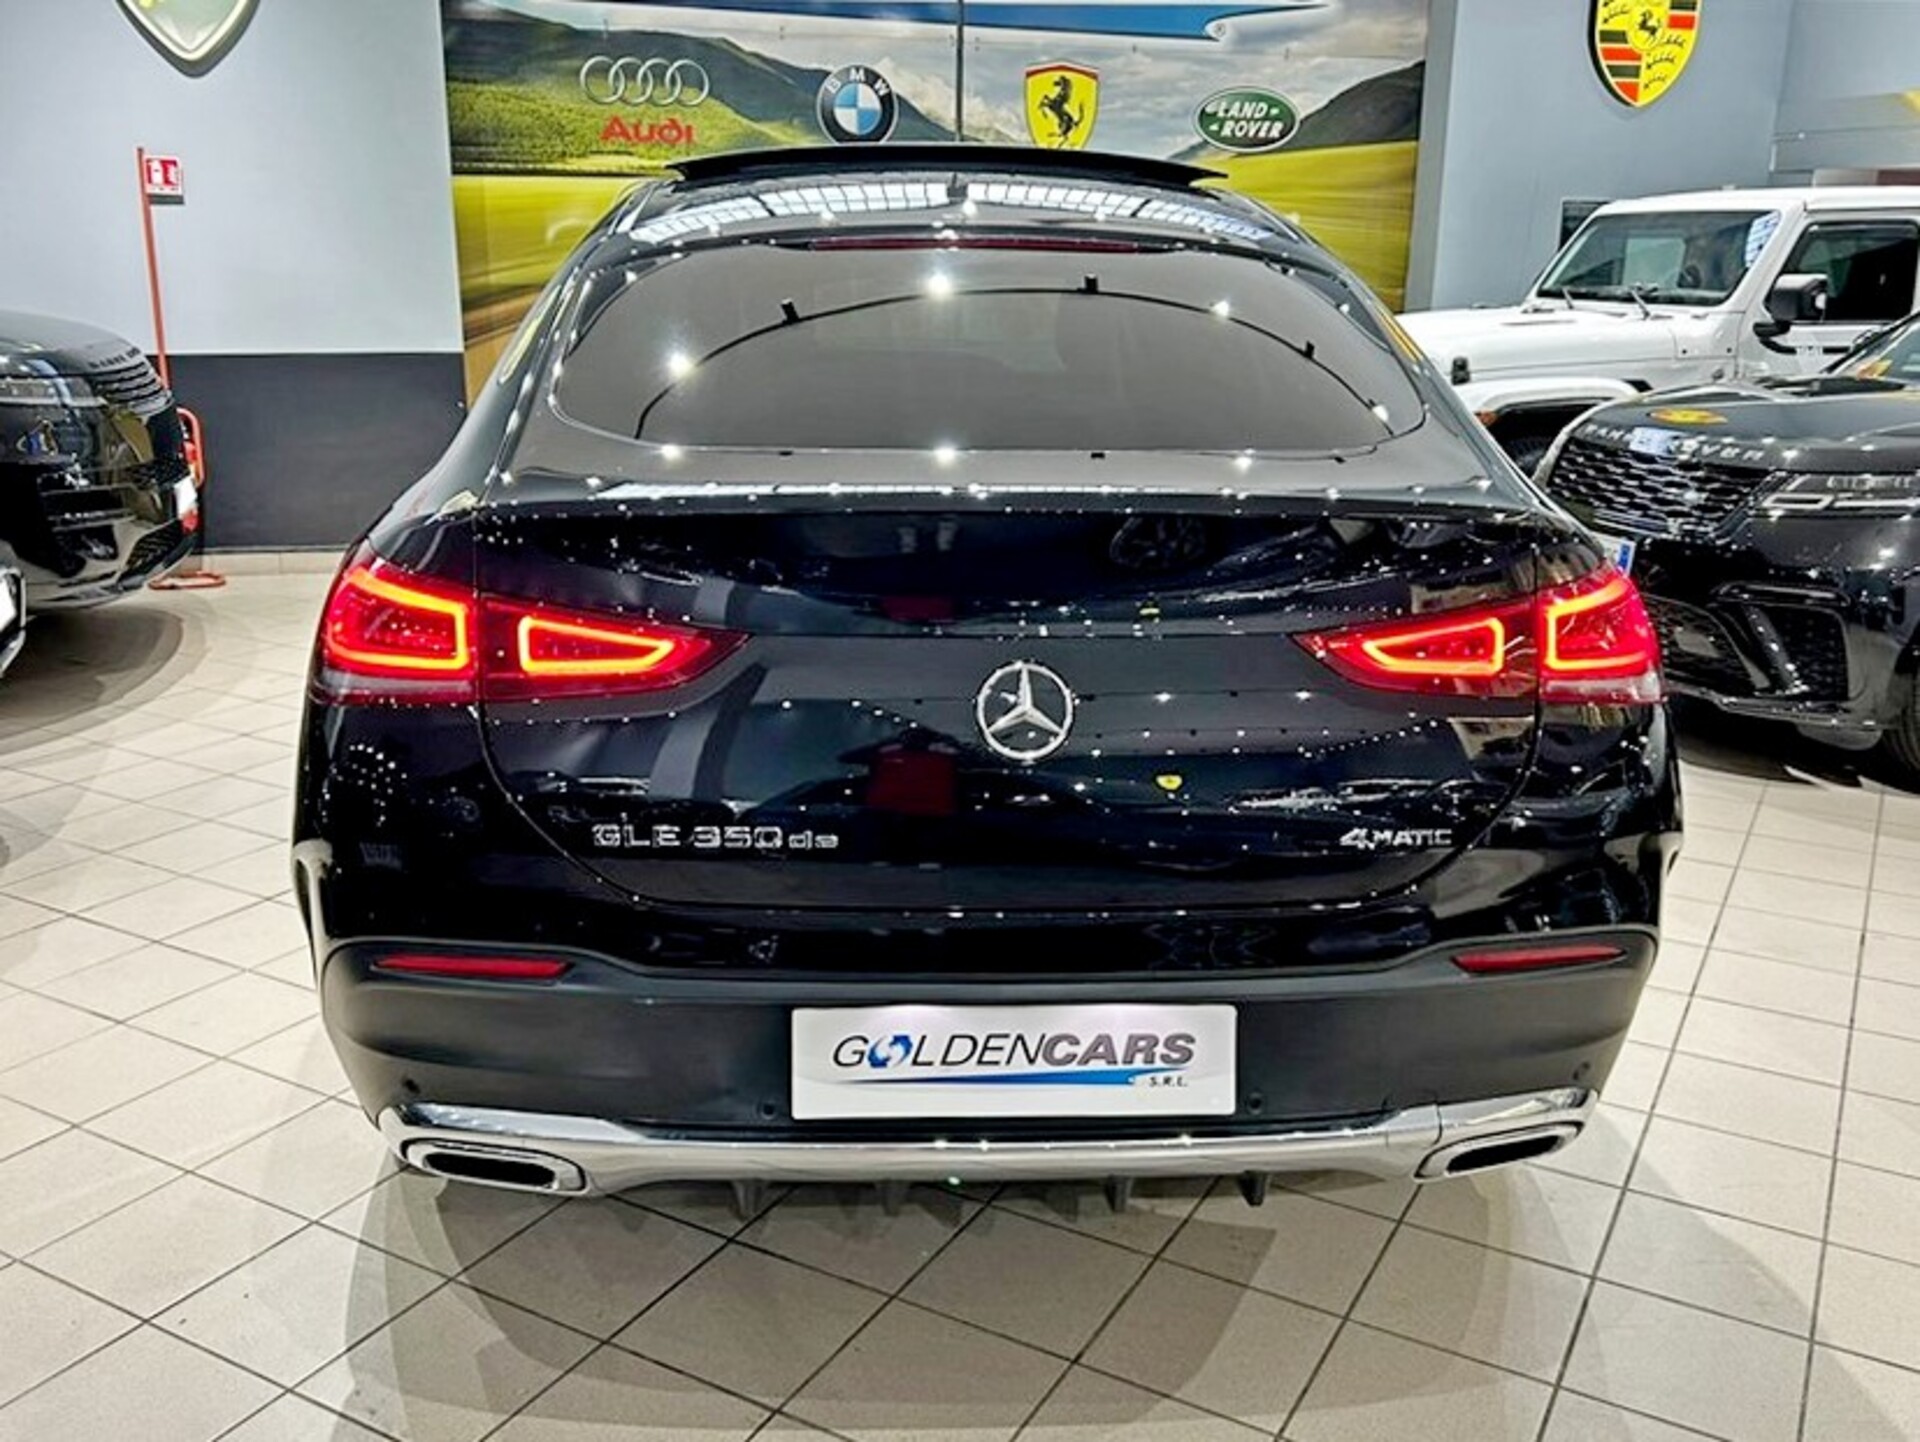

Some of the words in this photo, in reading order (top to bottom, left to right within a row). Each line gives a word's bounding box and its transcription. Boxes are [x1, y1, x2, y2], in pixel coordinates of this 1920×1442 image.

[825, 66, 891, 96] BMW
[1217, 101, 1268, 119] LAND
[600, 115, 693, 144] Audi
[1220, 120, 1283, 138] ROVER
[592, 824, 681, 847] GLE
[1339, 828, 1452, 849] 4MATIC
